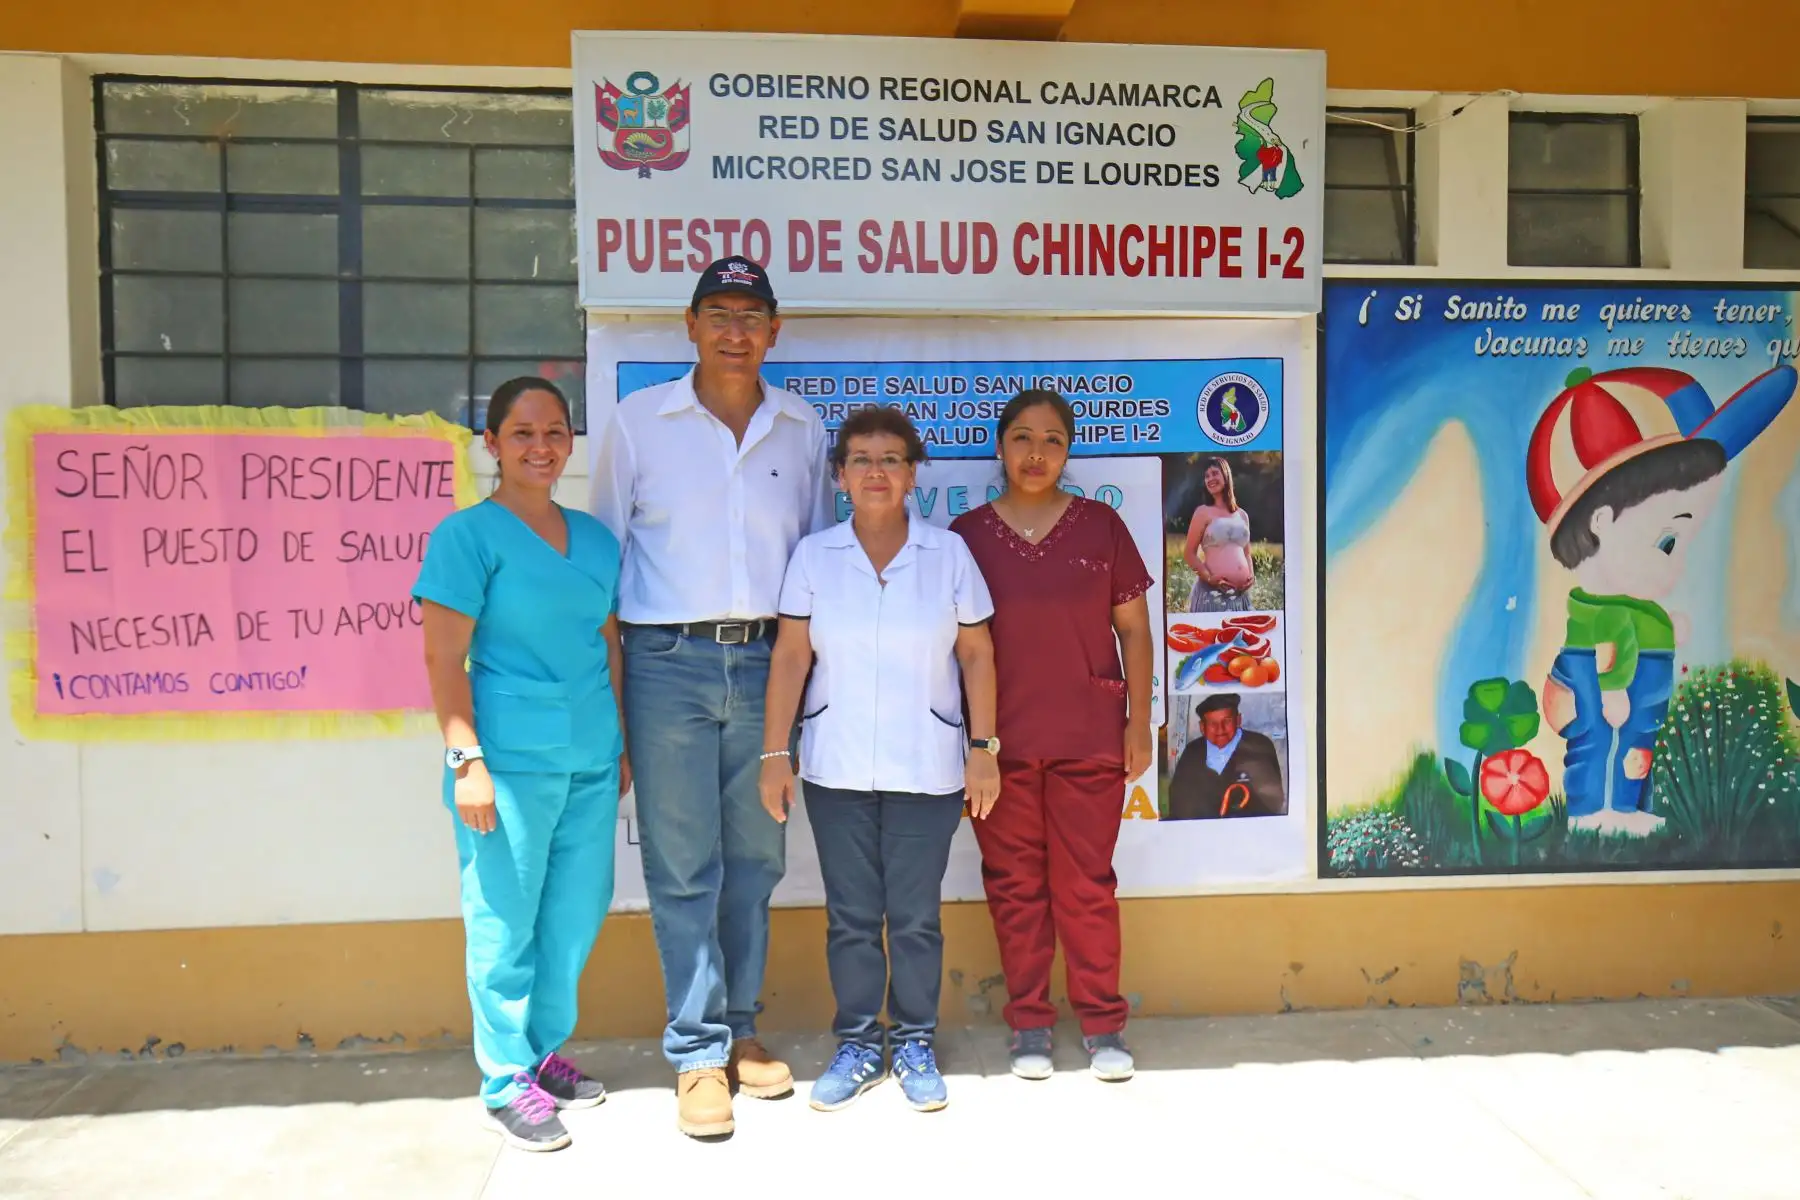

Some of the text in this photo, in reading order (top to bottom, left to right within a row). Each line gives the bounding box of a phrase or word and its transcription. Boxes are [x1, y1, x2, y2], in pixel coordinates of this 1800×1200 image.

[709, 72, 1222, 108] GOBIERNO REGIONAL CAJAMARCA
[759, 115, 1176, 147] RED DE SALUD SAN IGNACIO
[712, 155, 1220, 188] MICRORED SAN JOSE DE LOURDES
[597, 218, 1305, 279] PUESTO DE SALUD CHINCHIPE I-2
[1394, 294, 1422, 322] Si
[1444, 294, 1528, 320] Sanito
[1541, 300, 1580, 322] me
[1600, 296, 1692, 332] quieres
[1714, 298, 1792, 327] tener,
[1607, 334, 1645, 356] me
[1667, 330, 1748, 358] tienes
[1766, 338, 1800, 369] qu
[785, 375, 1133, 396] RED DE SALUD SAN IGNACIO
[1204, 386, 1212, 396] DE
[1212, 374, 1248, 388] SERVICIOS
[1255, 388, 1266, 412] SALUD
[944, 402, 1008, 420] JOSE
[1073, 400, 1170, 418] OURDES
[916, 427, 988, 445] ALUD
[1133, 424, 1160, 441] I-2
[1212, 432, 1254, 444] SAN IGNACIO
[56, 444, 454, 502] SEÑOR PRESIDENTE
[62, 530, 108, 573] EL
[143, 527, 258, 568] PUESTO
[284, 531, 314, 563] DE
[70, 598, 424, 655] NECESITA DE TU APOYO
[52, 666, 308, 701] ¡CONTAMOS CONTIGO!
